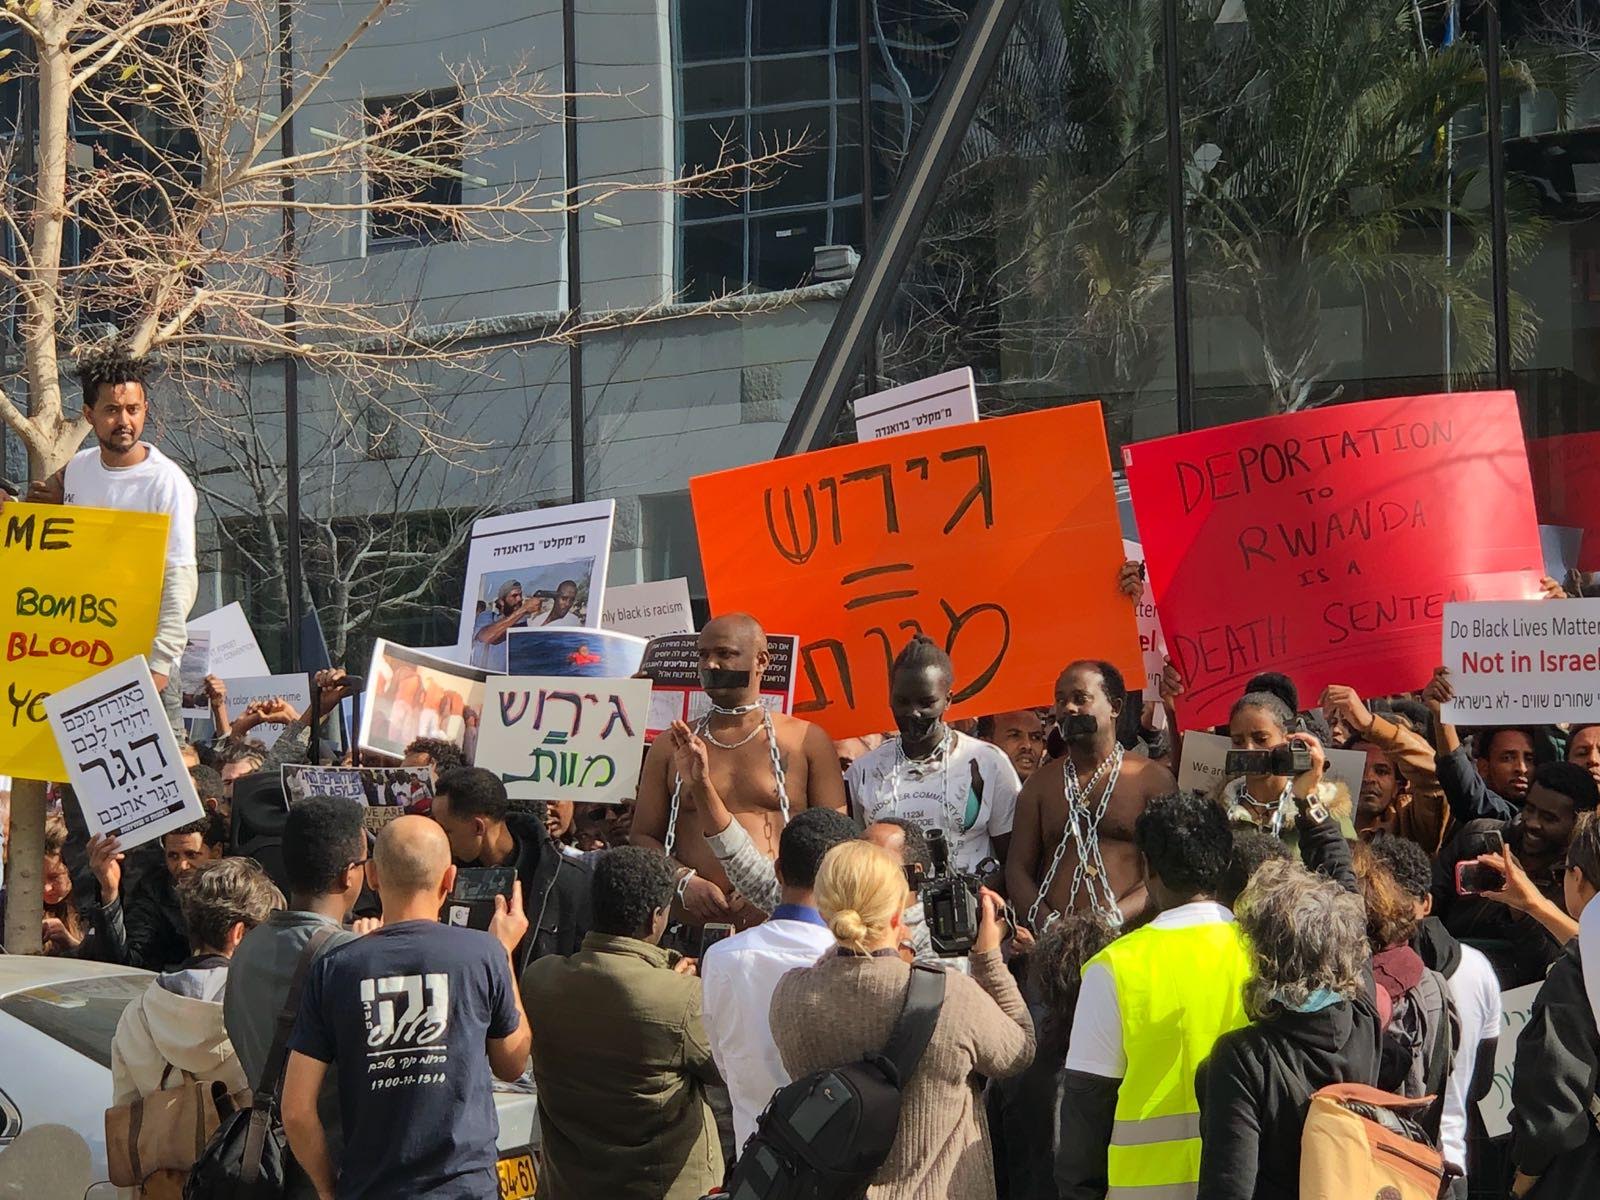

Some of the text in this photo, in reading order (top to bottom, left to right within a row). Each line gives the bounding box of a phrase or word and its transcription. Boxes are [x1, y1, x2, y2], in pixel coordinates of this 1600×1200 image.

[874, 420, 910, 438] ברואנדה
[1176, 420, 1452, 513] DEPORTATION
[763, 445, 994, 565] גירוש
[1297, 487, 1334, 505] TO
[4, 514, 74, 551] ME
[1237, 500, 1427, 571] RWANDA
[493, 542, 535, 557] ברואנדה
[1299, 560, 1361, 587] IS A
[16, 587, 118, 627] BOMBS
[601, 602, 683, 624] nly black is racism
[1451, 620, 1468, 638] Do
[1473, 618, 1509, 638] Black
[1513, 618, 1548, 637] Lives
[7, 632, 114, 667] BLOOD
[1173, 615, 1288, 689] DEATH
[1462, 647, 1600, 674] Not in Israel
[1495, 691, 1509, 709] לא
[1522, 693, 1549, 708] שווים
[1553, 692, 1594, 708] שחורים
[499, 688, 635, 740] גירוש
[502, 747, 616, 788] מוות
[1192, 760, 1209, 773] We
